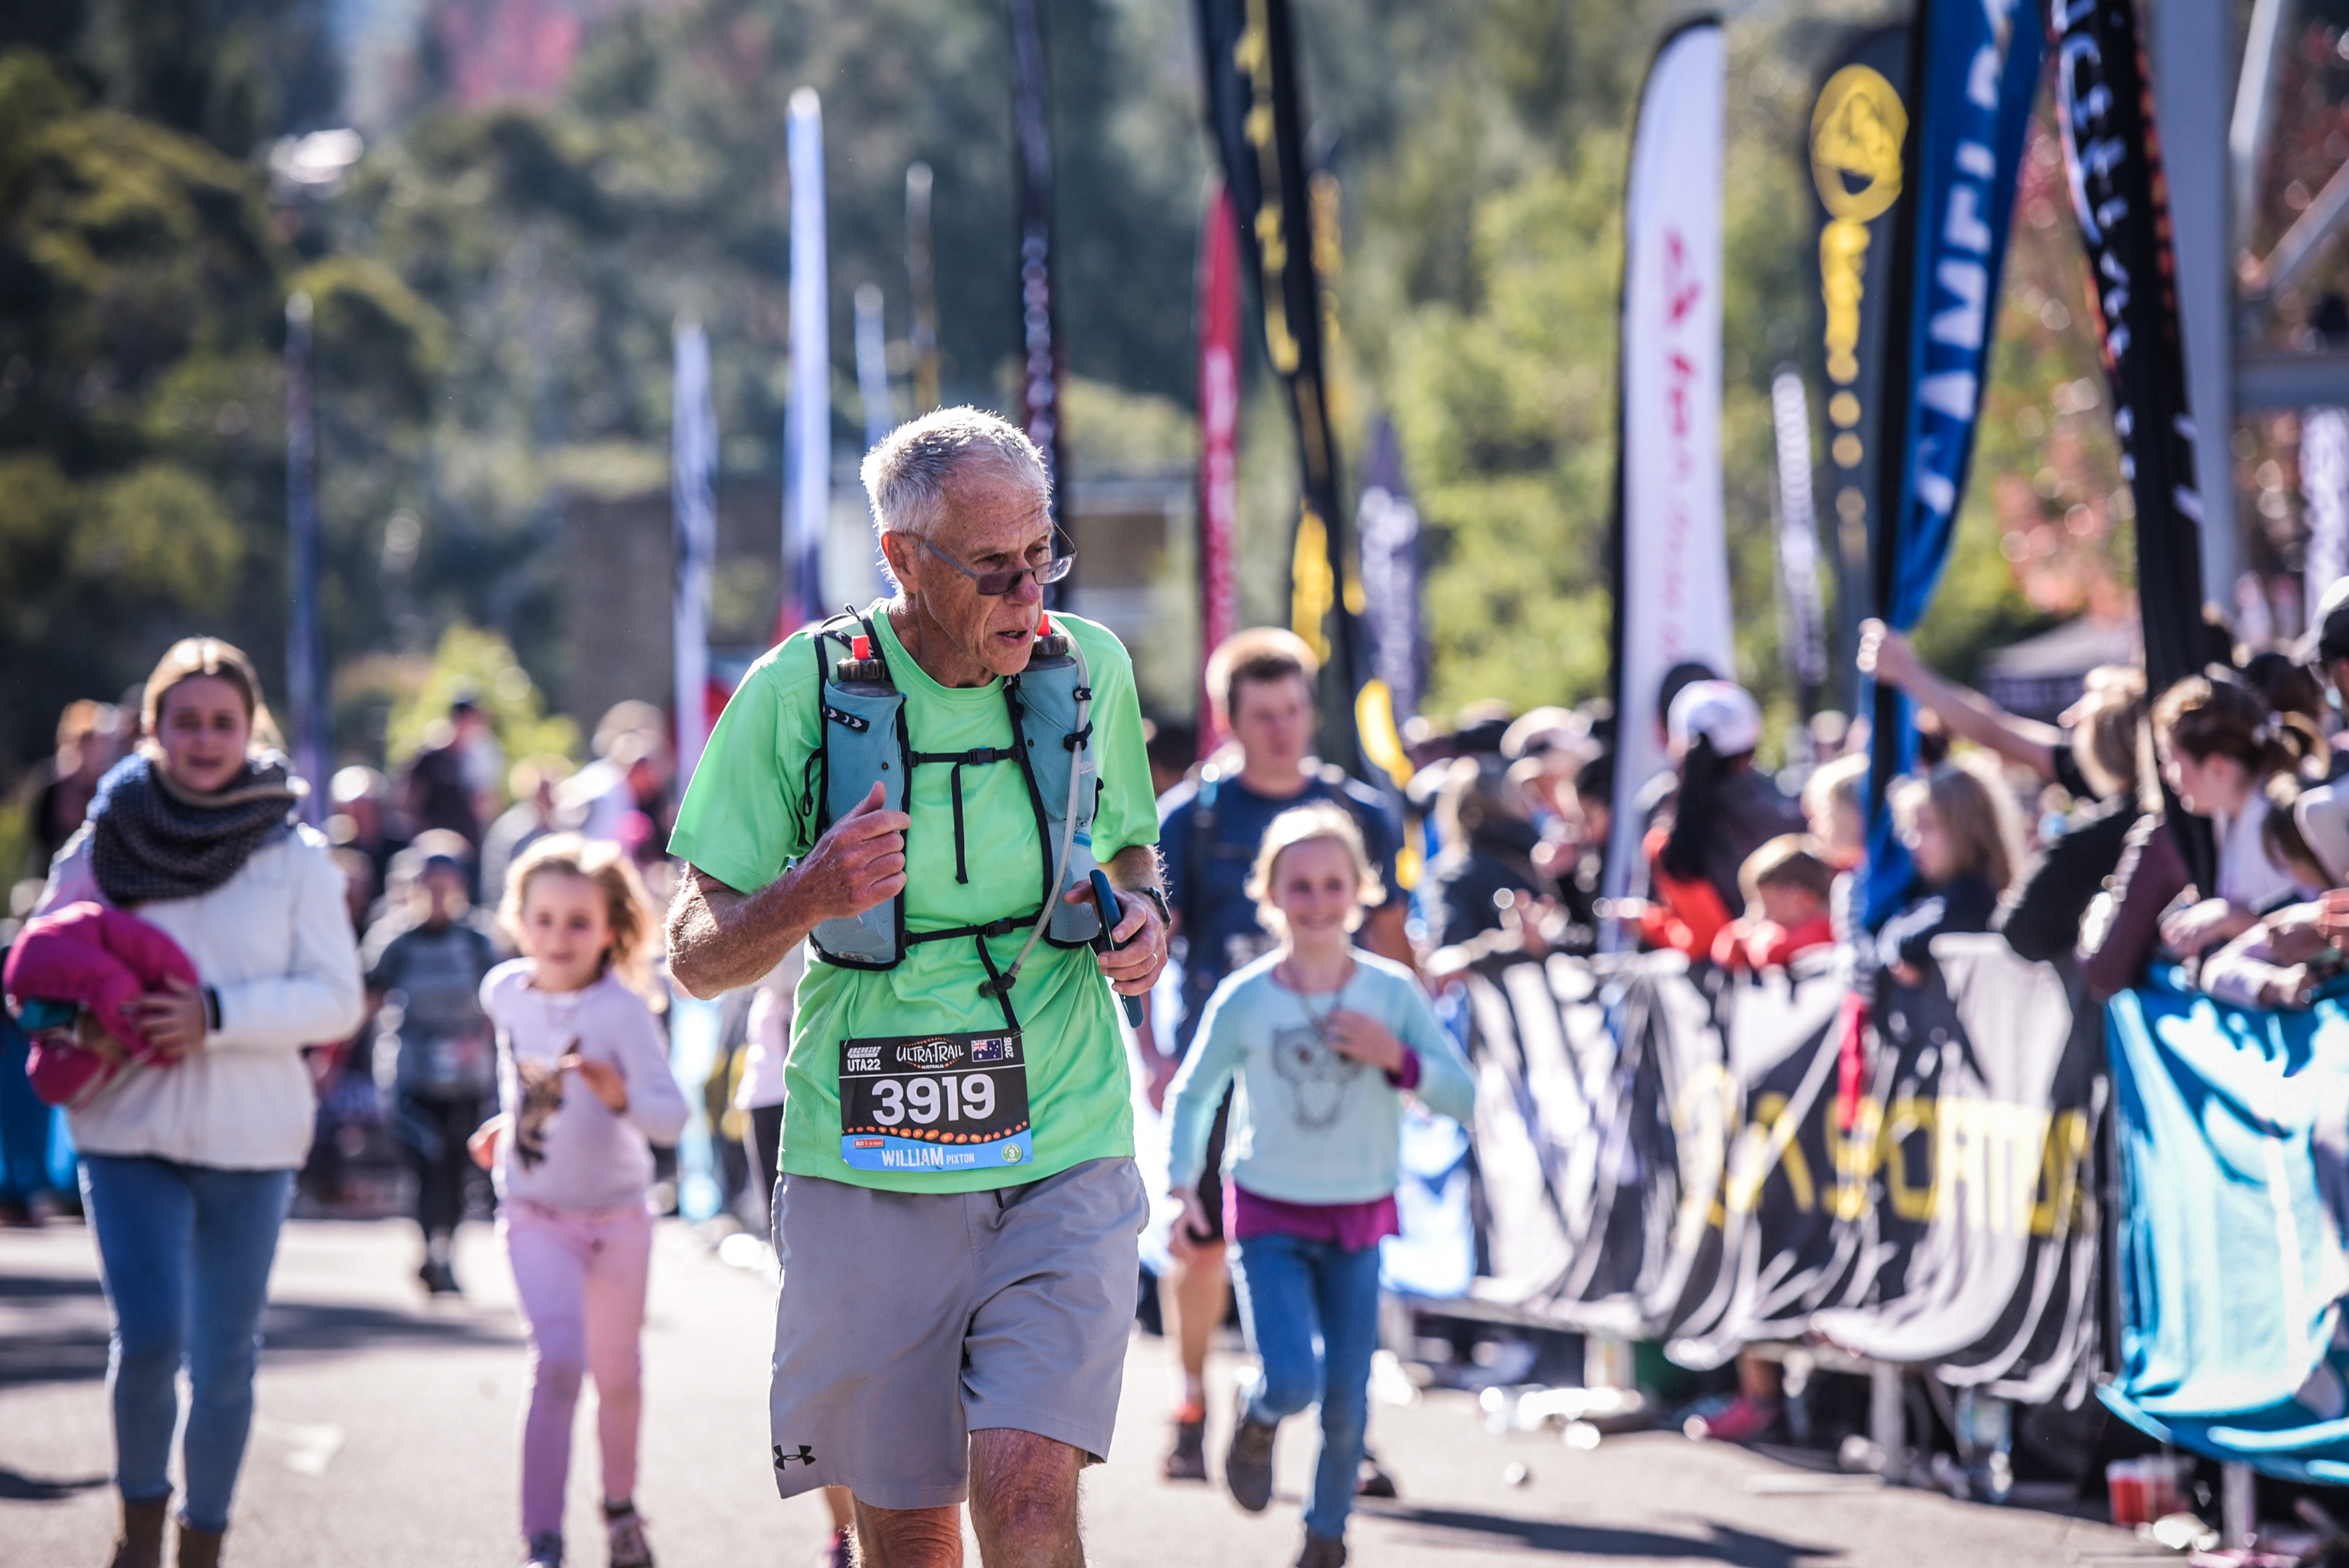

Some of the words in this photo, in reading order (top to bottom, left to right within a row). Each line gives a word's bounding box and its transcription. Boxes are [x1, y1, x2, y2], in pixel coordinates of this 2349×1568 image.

[1003, 1036, 1014, 1058] 2018
[847, 1058, 881, 1072] UTA22
[872, 1074, 995, 1126] 3919
[881, 1147, 944, 1167] WILLIAM
[946, 1153, 975, 1165] PIXTON
